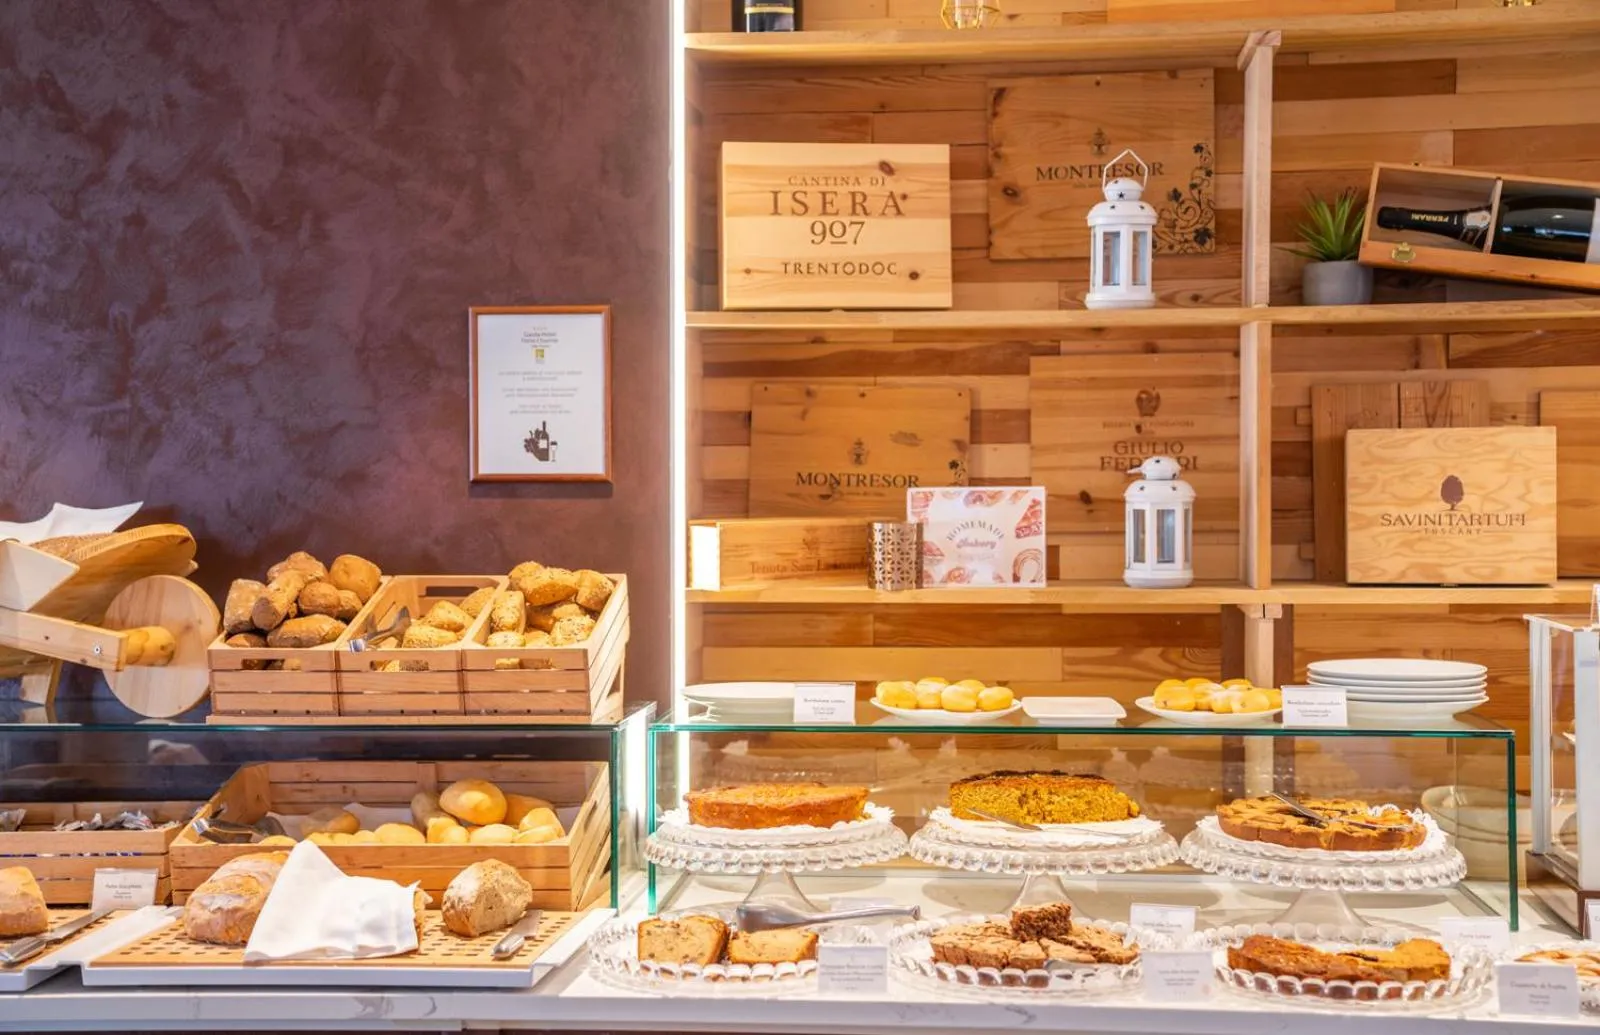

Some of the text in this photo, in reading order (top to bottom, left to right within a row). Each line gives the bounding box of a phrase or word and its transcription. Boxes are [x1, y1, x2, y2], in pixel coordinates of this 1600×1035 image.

[1036, 162, 1164, 181] MONTRESOR
[788, 176, 886, 187] CANTINA DI
[770, 190, 906, 217] ISERA
[810, 220, 865, 245] 907
[781, 261, 897, 276] TRENTODOC
[1113, 440, 1184, 455] GIULIO
[1100, 455, 1198, 472] FERRI
[796, 471, 920, 488] MONTRESOR
[946, 519, 1005, 541] HOMEMADE
[1423, 527, 1481, 535] TUSCANY
